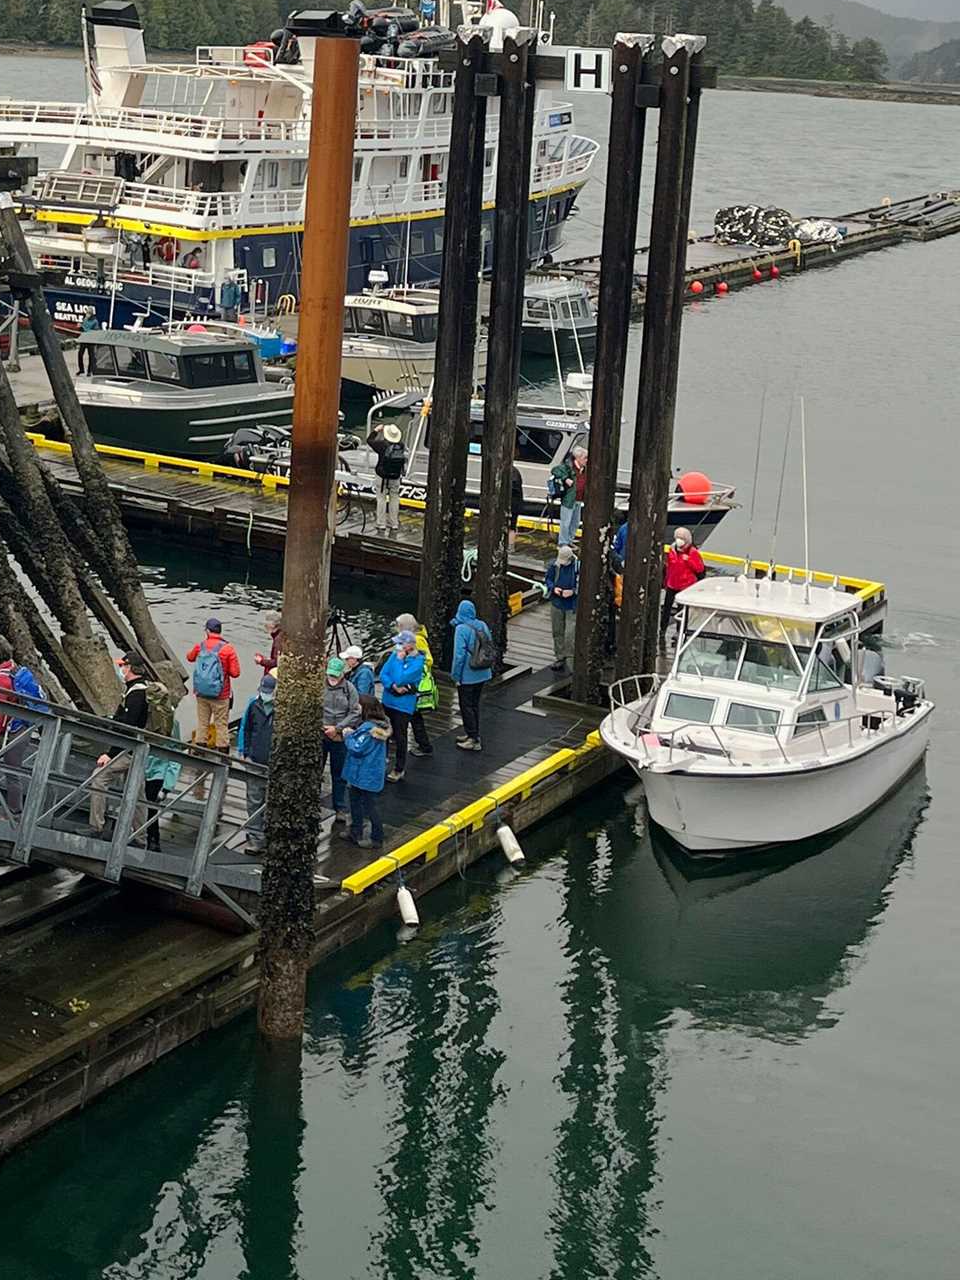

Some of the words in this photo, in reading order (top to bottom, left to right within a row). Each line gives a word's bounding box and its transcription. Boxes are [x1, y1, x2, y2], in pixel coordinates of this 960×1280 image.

[573, 53, 603, 89] H
[76, 277, 124, 291] GEOGPHIC
[55, 301, 73, 313] SEA
[54, 312, 84, 323] SEATTLE
